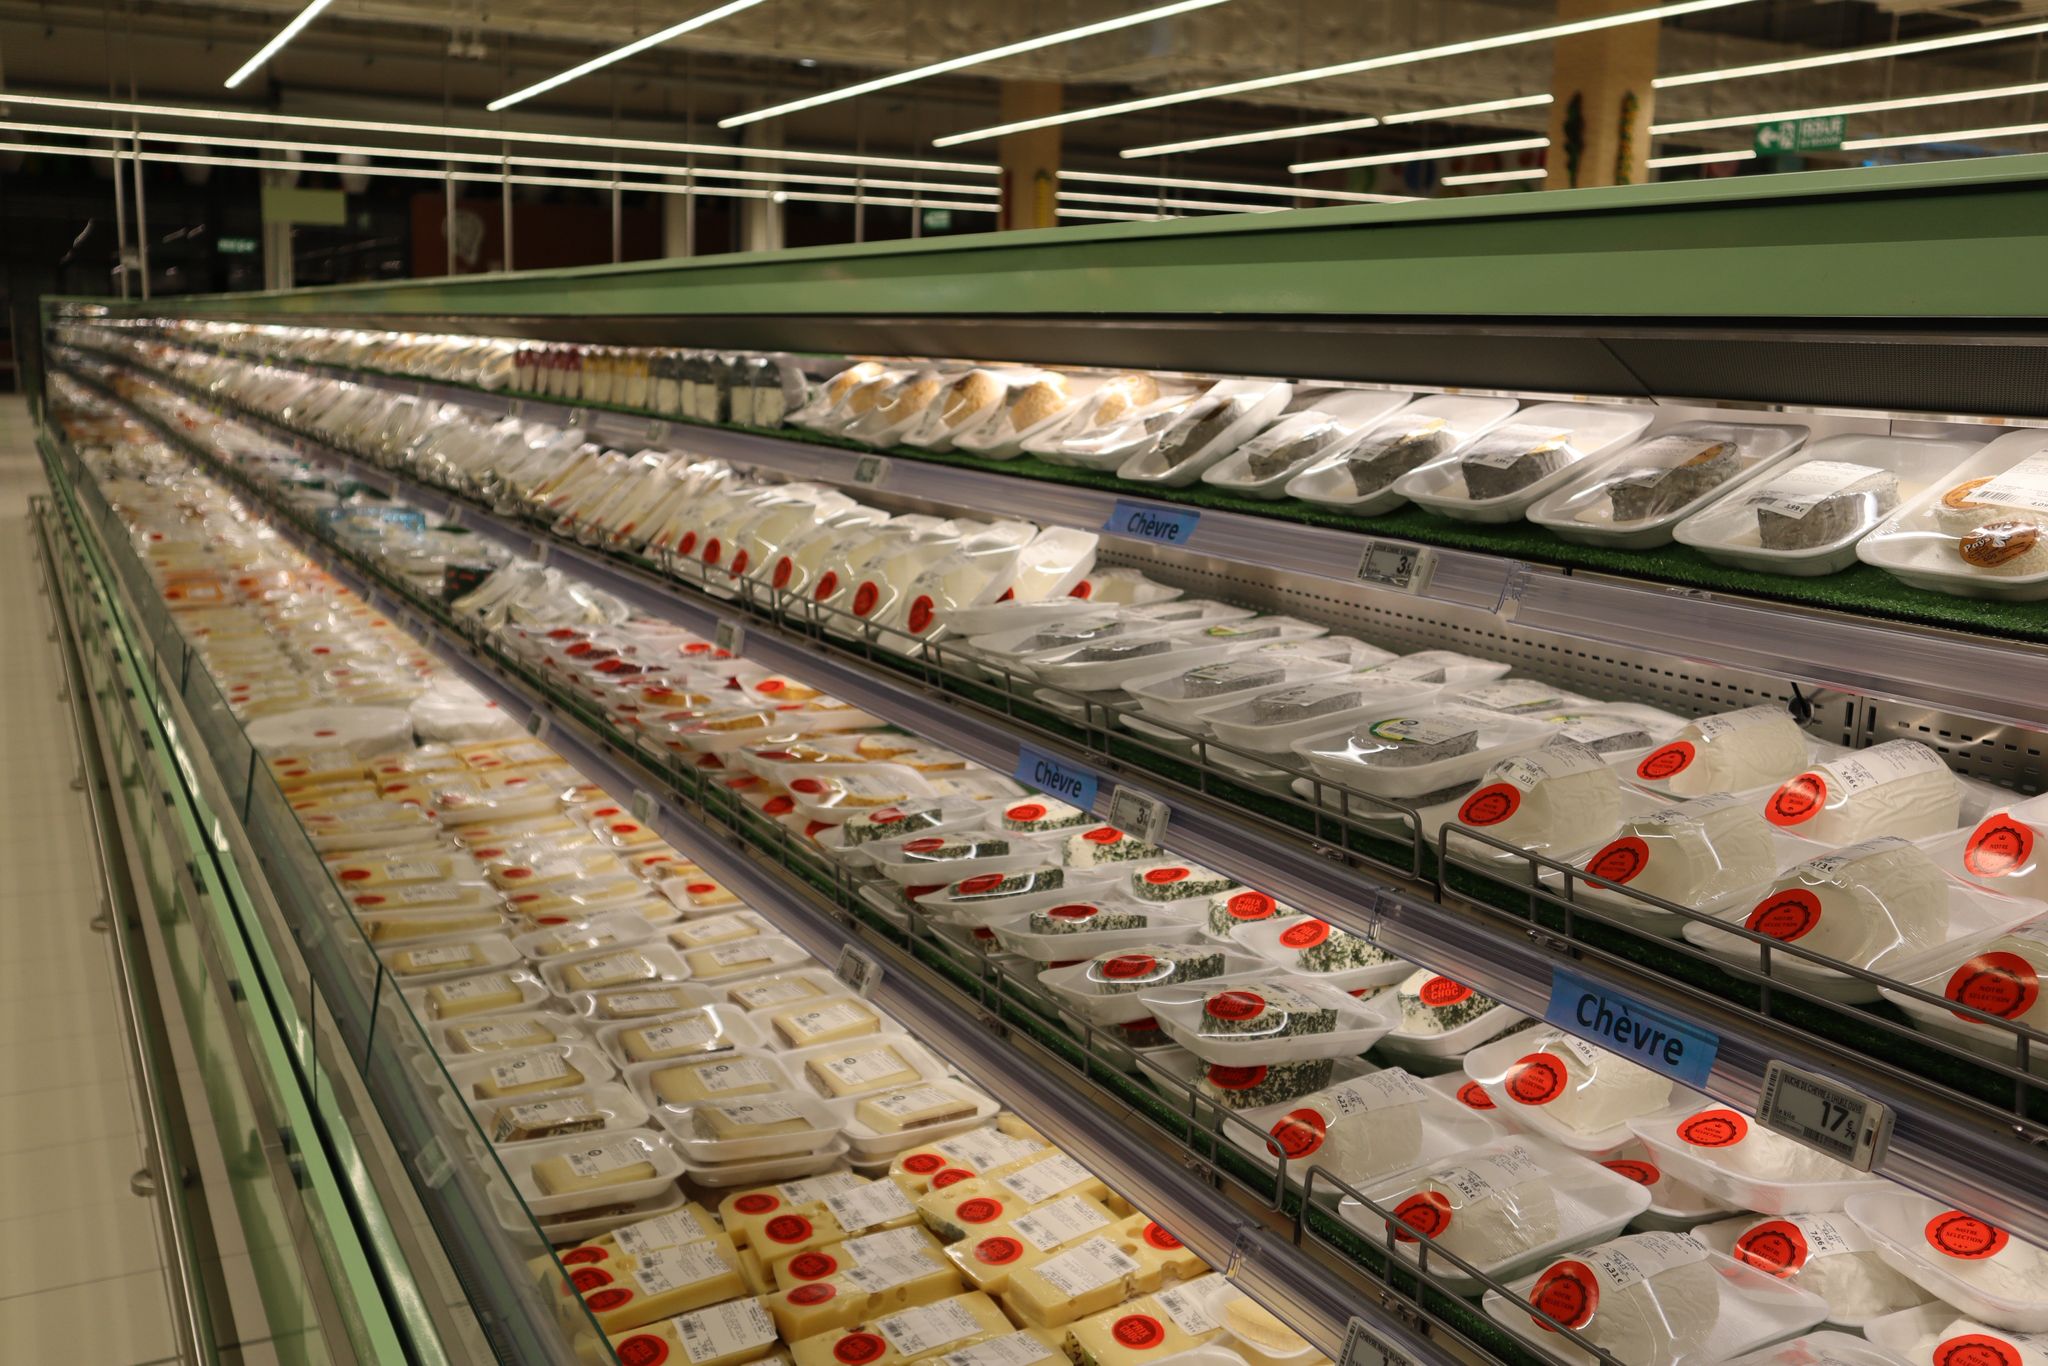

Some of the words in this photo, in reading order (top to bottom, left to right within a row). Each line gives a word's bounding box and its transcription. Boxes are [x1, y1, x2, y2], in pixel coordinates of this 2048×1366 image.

[1127, 511, 1180, 541] Chèvre
[1396, 556, 1408, 574] 3
[1034, 759, 1083, 799] Chèvre
[1431, 982, 1459, 992] PRIX
[1431, 989, 1459, 1001] CHOC
[1576, 992, 1684, 1067] Chèvre
[1820, 1100, 1849, 1132] 17
[1945, 1231, 1984, 1244] SELECTION
[1955, 1227, 1978, 1236] NOTRE
